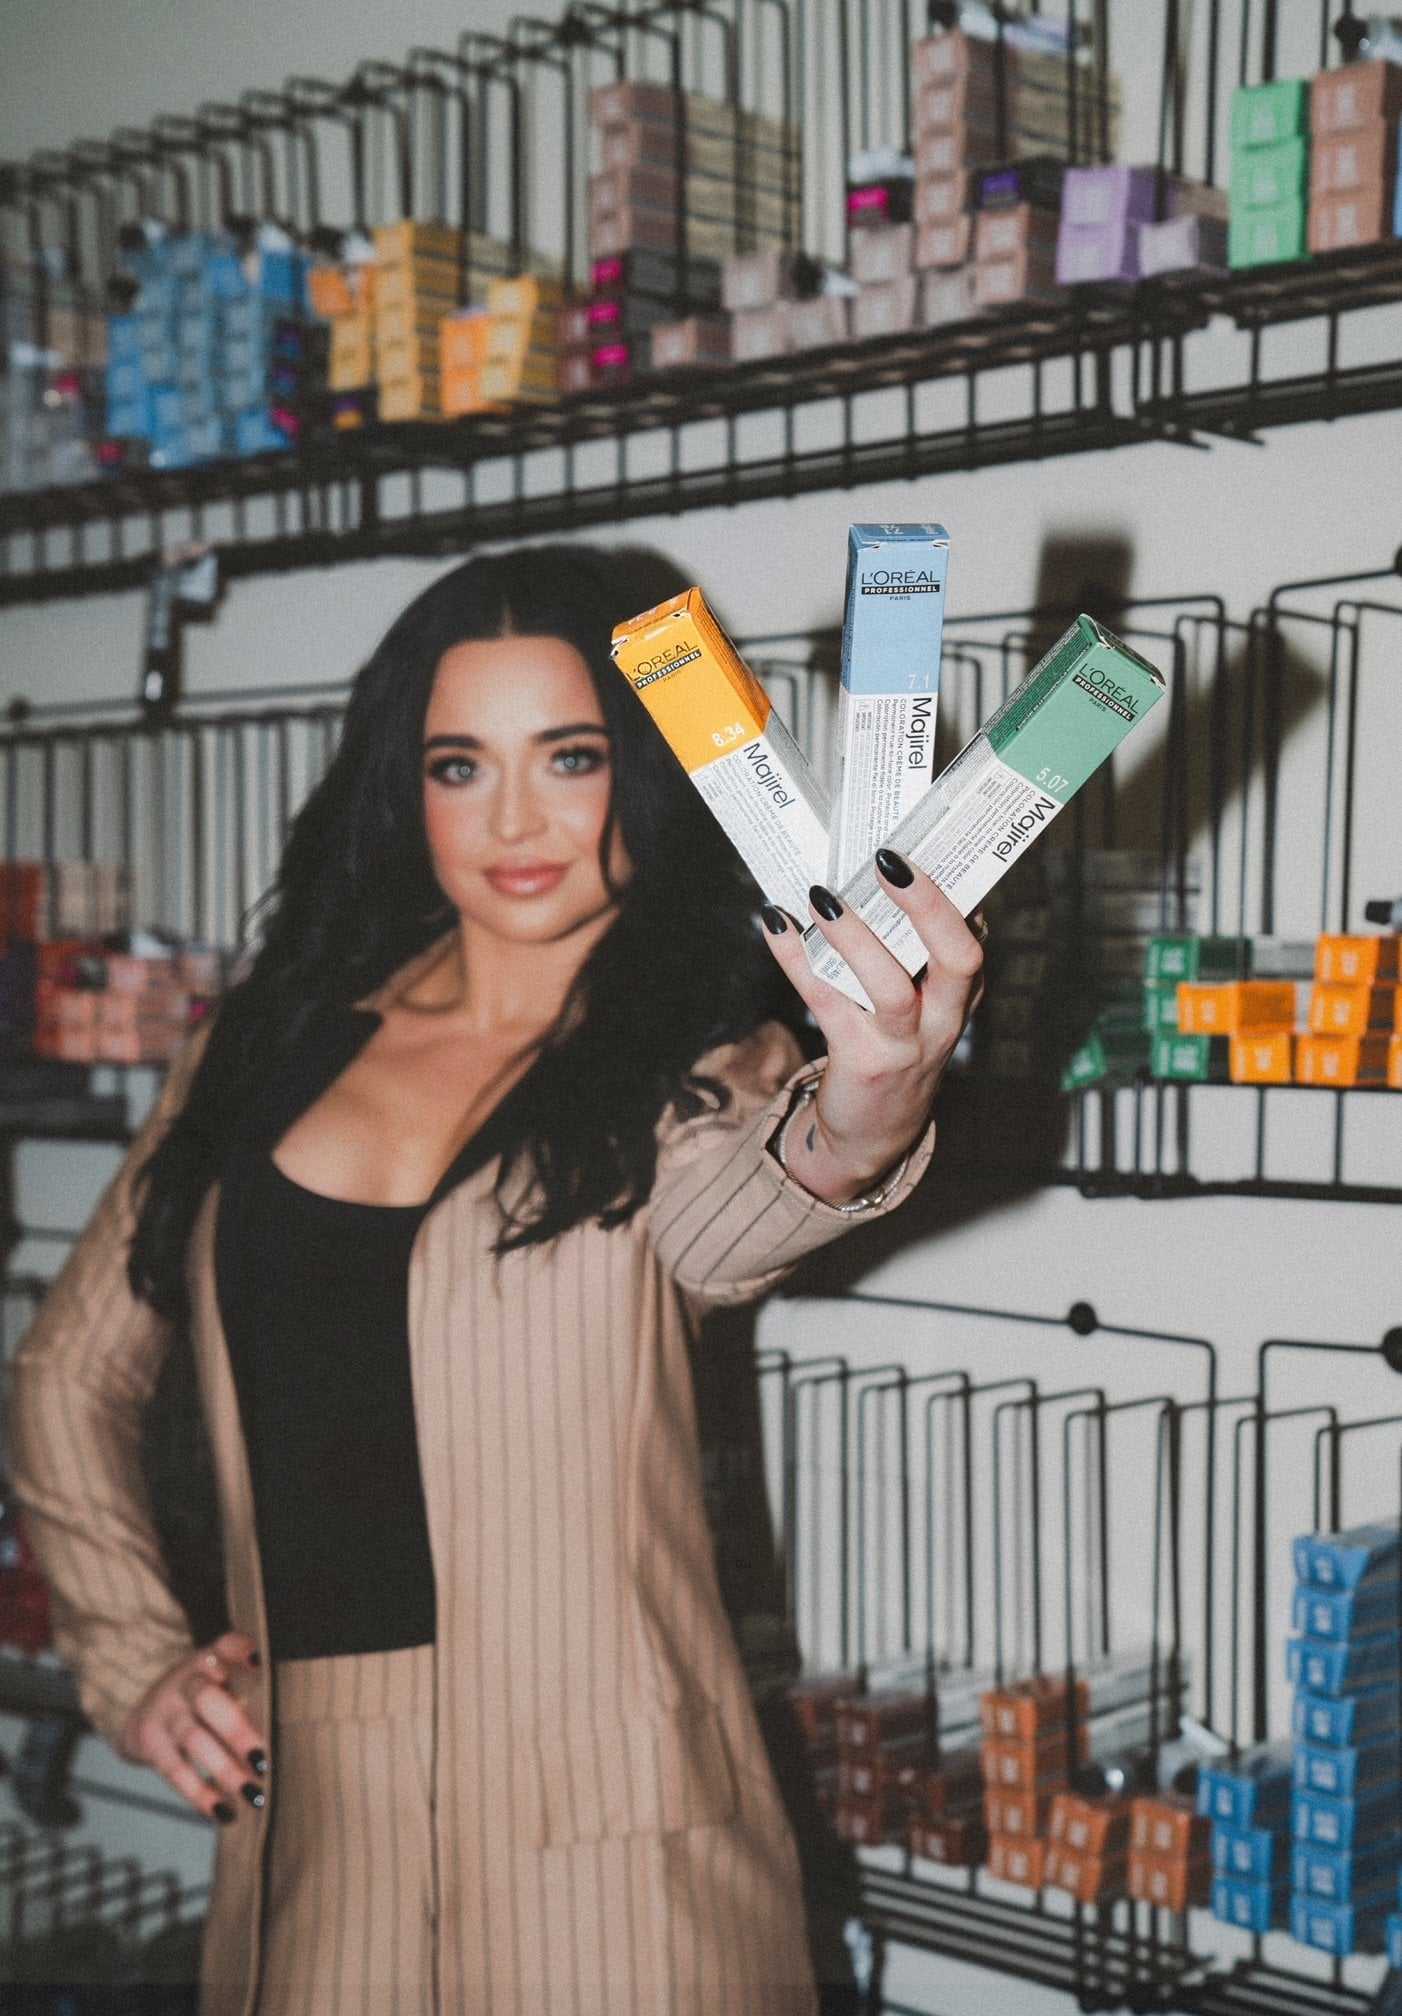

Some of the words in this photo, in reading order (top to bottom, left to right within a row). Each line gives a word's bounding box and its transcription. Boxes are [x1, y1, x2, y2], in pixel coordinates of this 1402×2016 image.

[862, 570, 940, 585] L'ORÉAL
[864, 585, 937, 594] PROFESSIONNEL
[636, 651, 701, 689] PROFESSIONNEL
[907, 673, 930, 689] 7.1
[1079, 662, 1138, 714] L'ORÉAL
[1074, 676, 1132, 721] PROFESSIONNEL
[711, 722, 746, 748] 8.34
[897, 699, 905, 748] COLORATION
[906, 698, 932, 768] Majirel
[743, 742, 795, 808] Majirel
[1036, 767, 1069, 793] 5.07
[992, 796, 1055, 862] Majirel
[996, 789, 1036, 832] COLORATION
